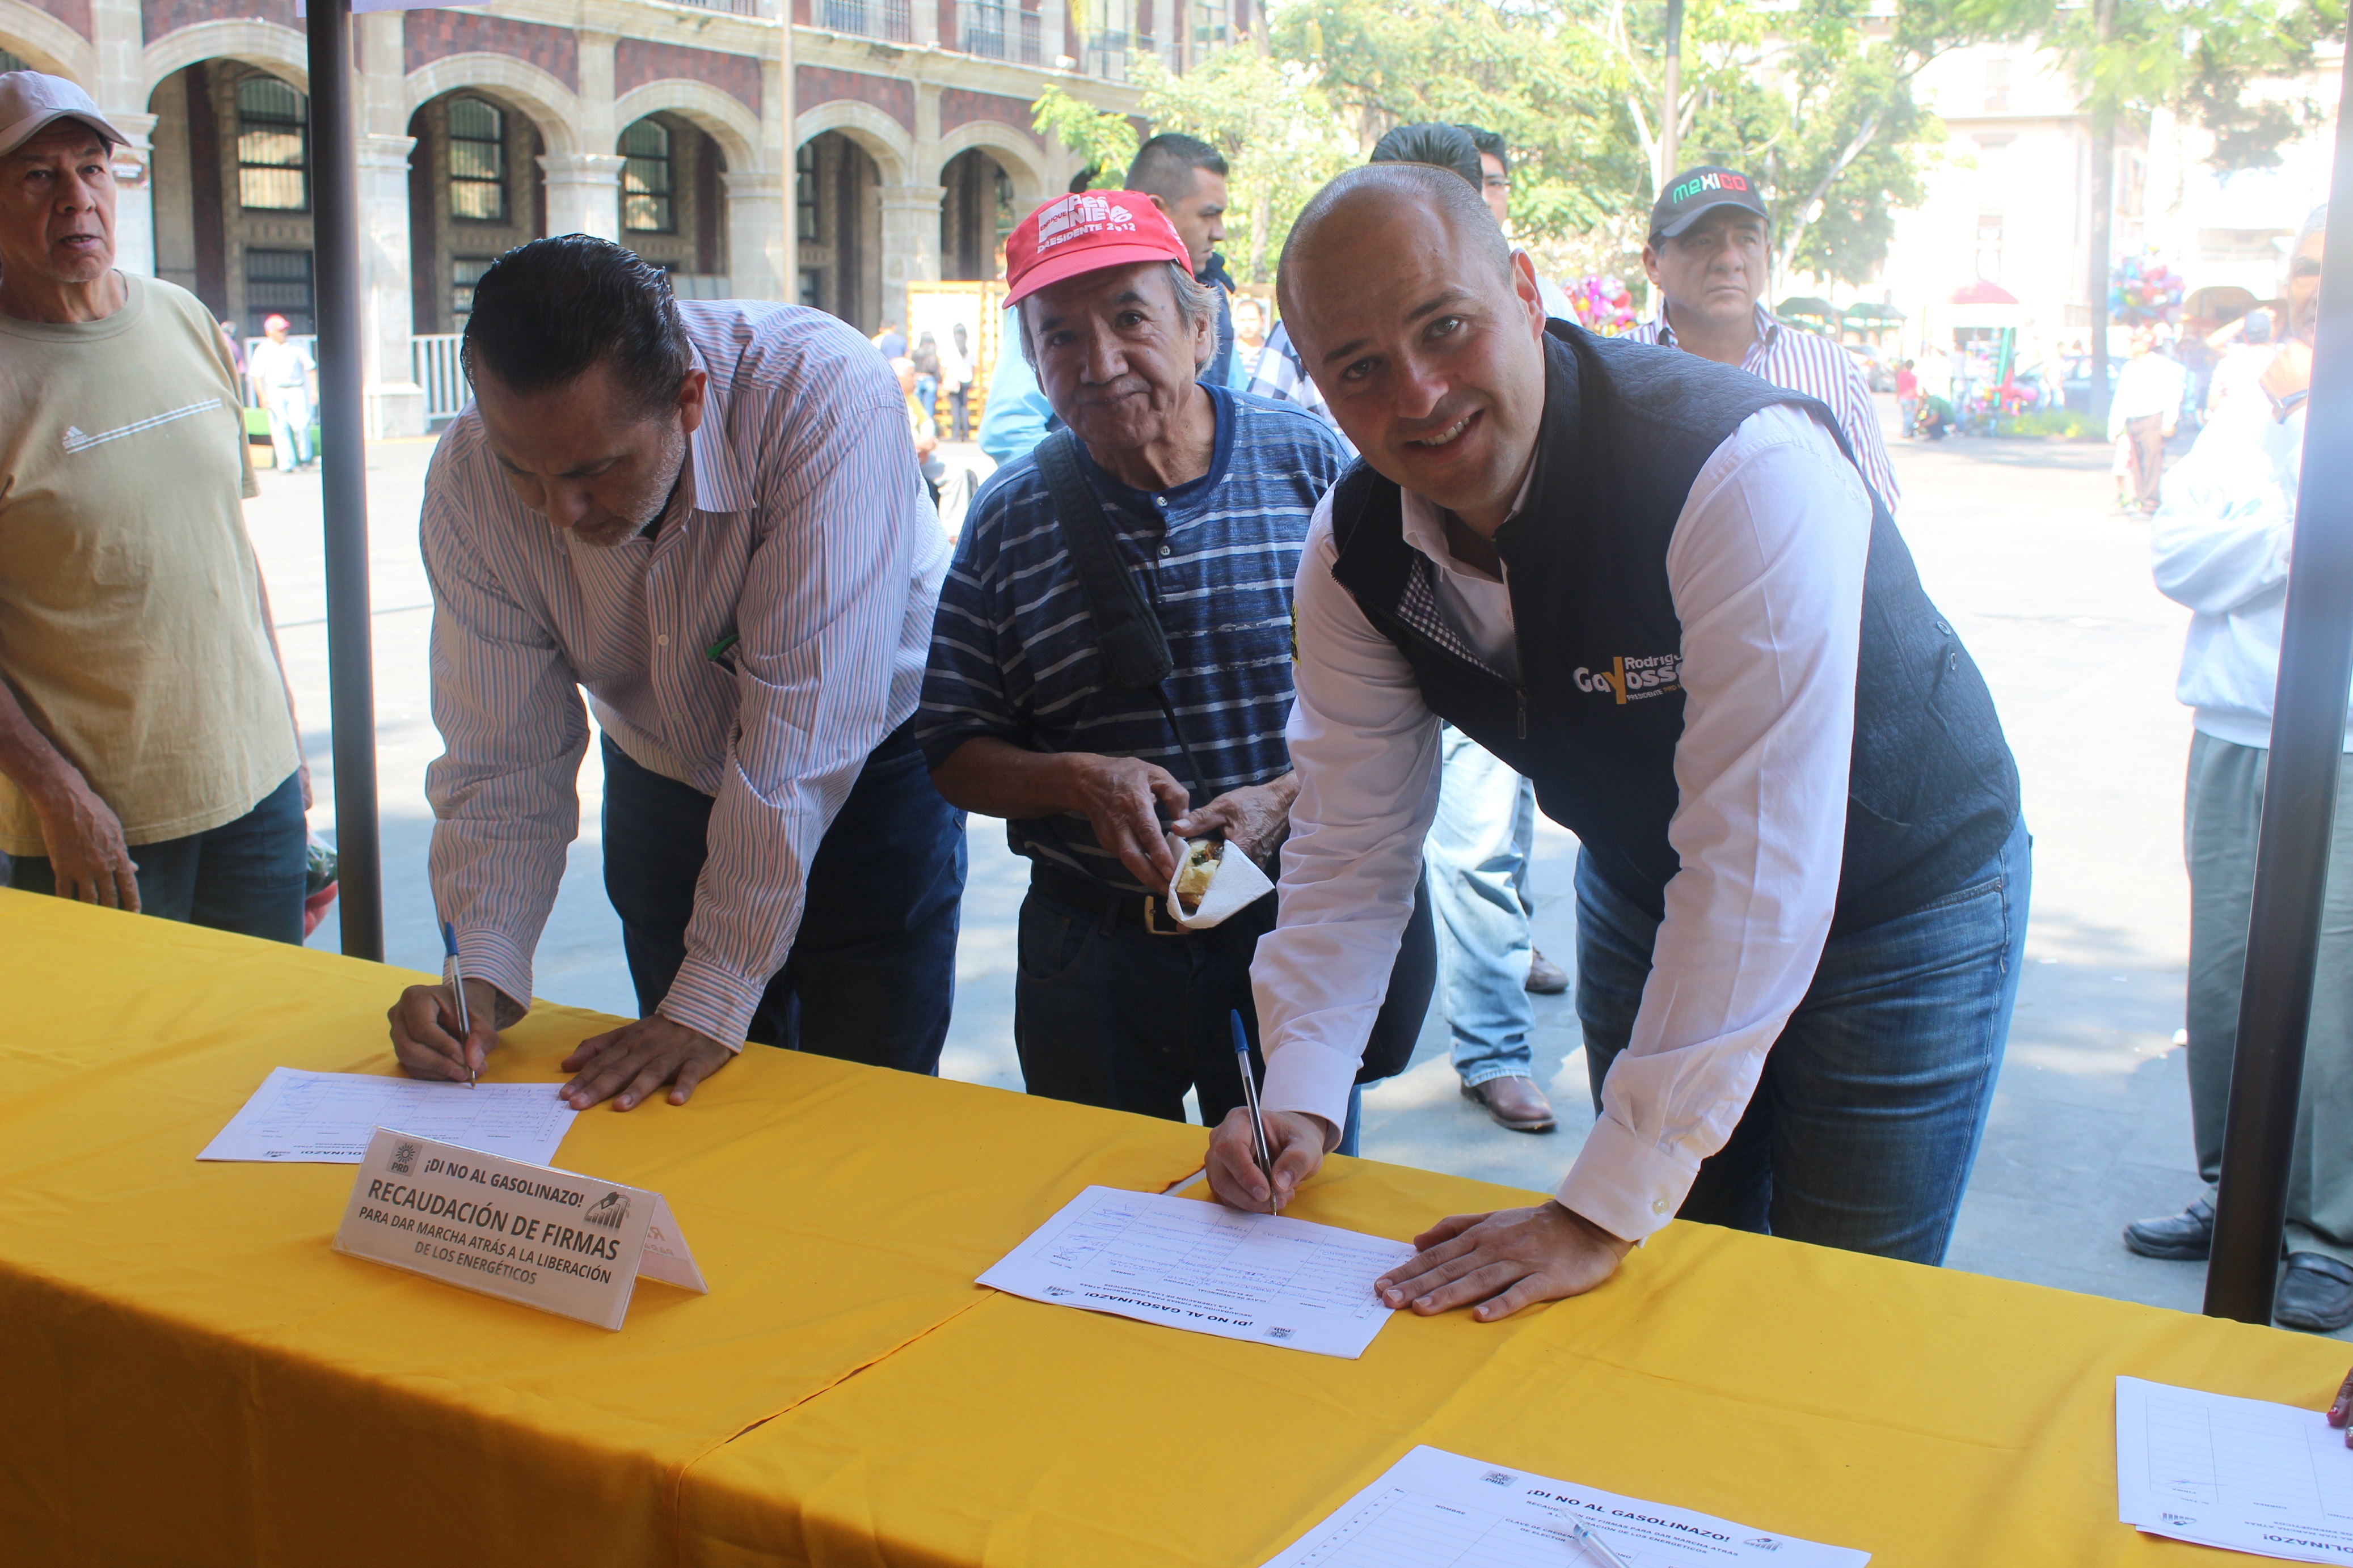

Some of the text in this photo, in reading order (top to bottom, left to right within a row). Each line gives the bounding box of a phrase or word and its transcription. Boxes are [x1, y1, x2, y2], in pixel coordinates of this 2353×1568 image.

[1069, 208, 1133, 227] NIEO
[1107, 222, 1136, 232] 2012
[1626, 688, 1663, 701] PRESIDENTE
[391, 1162, 409, 1173] PRD
[424, 1159, 584, 1208] ¡DI NO AL GASOLINAZO!
[368, 1179, 509, 1232] RECAUDACIÓN
[511, 1215, 540, 1240] DE
[541, 1223, 621, 1261] FIRMAS
[359, 1206, 612, 1284] PARA DAR MARCHA ATRÁS A LA LIBERACIÓN
[415, 1241, 537, 1284] DE LOS ENERGÉTICOS
[1084, 1292, 1180, 1313] GASOLINAZO!
[1435, 1504, 1466, 1515] NOMBRE
[1526, 1490, 1730, 1542] ¡DI NO AL GASOLINAZO!
[1506, 1518, 1529, 1527] CLAVE
[1543, 1528, 1579, 1541] CREDENC
[1532, 1531, 1566, 1542] ELECTOR
[1599, 1519, 1628, 1529] FIRMAS
[1673, 1536, 1708, 1549] MARCHA
[2277, 1526, 2316, 1536] MARCHA
[2262, 1534, 2353, 1553] OLINAZO!
